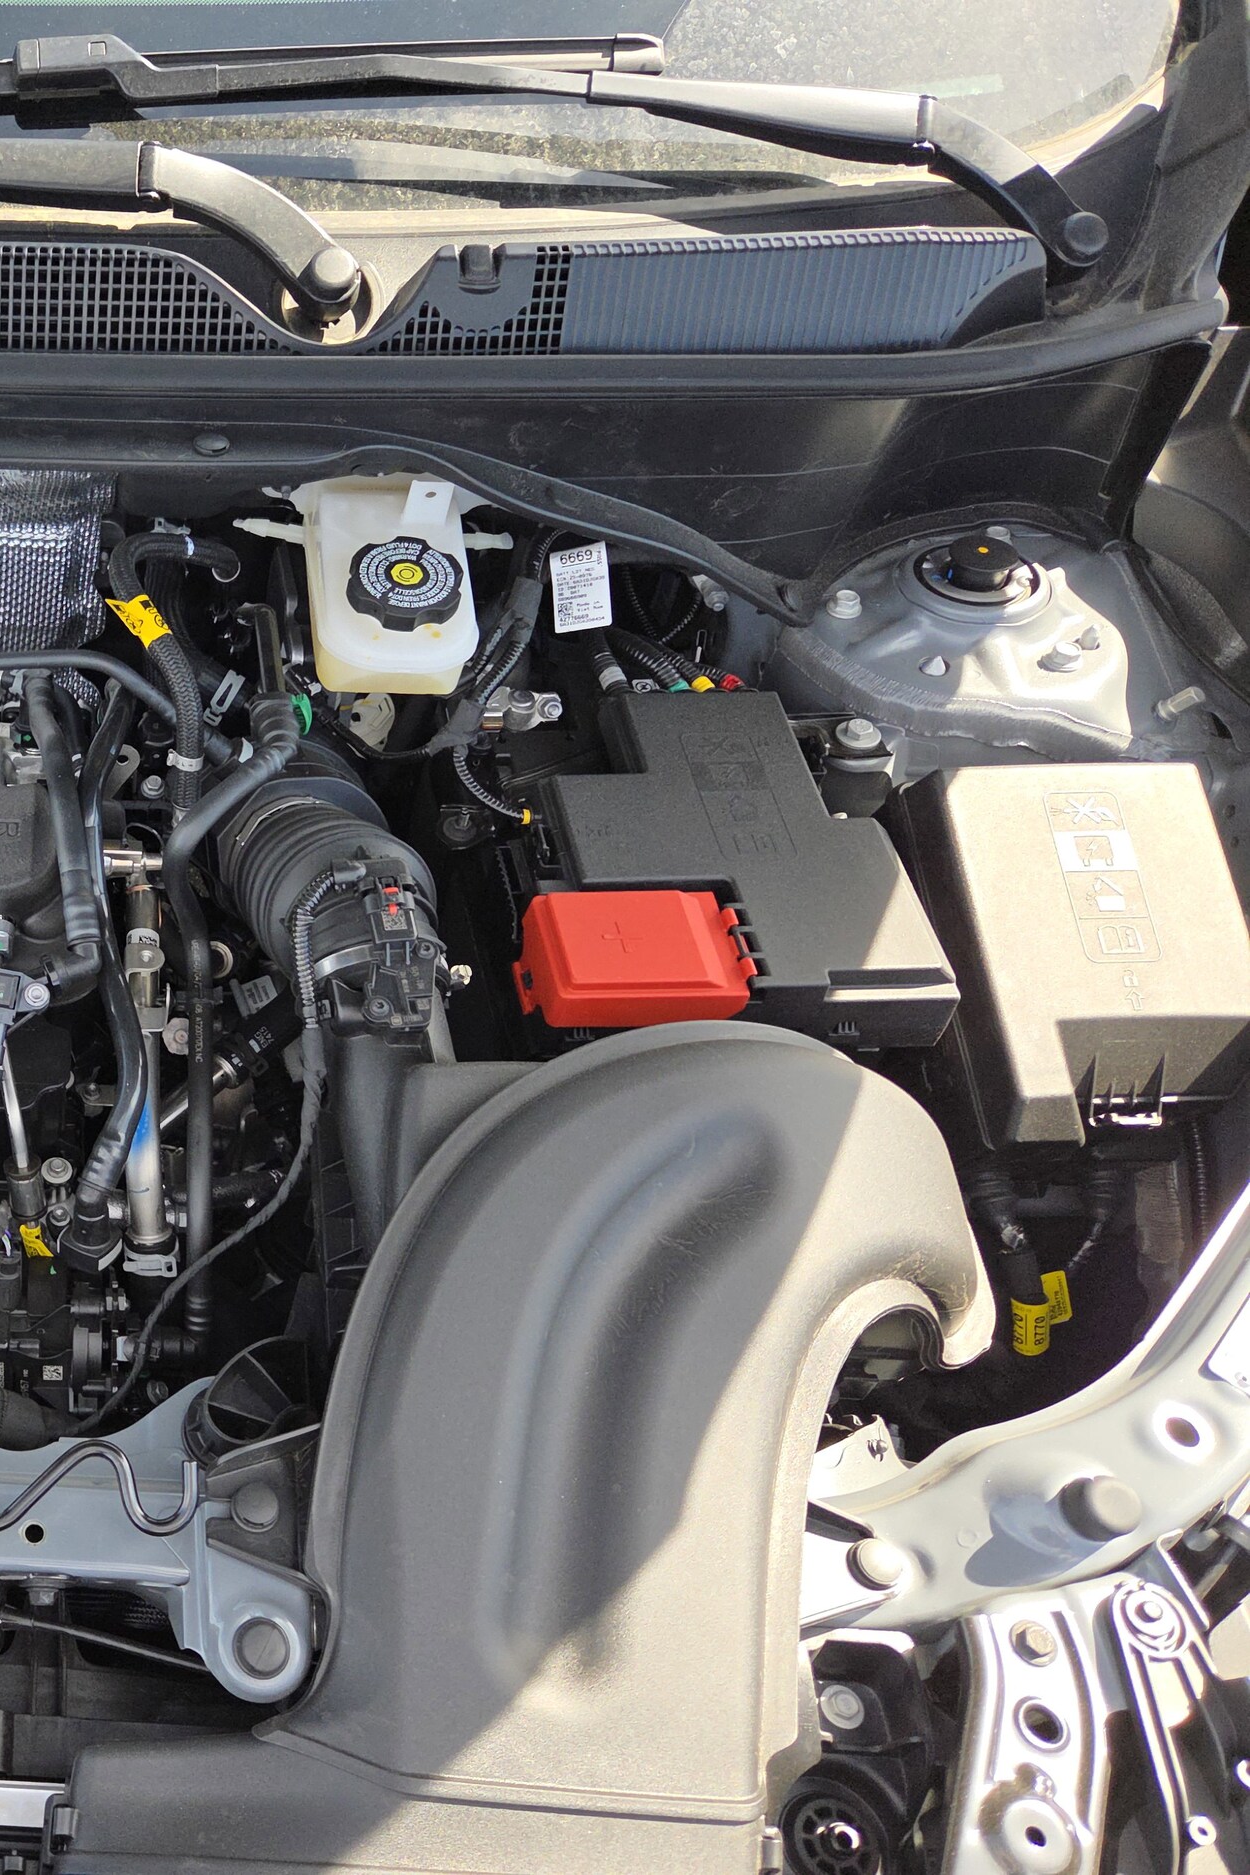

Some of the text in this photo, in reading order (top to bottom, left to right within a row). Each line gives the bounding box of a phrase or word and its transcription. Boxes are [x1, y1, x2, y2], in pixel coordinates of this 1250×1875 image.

[560, 549, 593, 565] 6669
[254, 1031, 268, 1049] ENG
[1034, 1315, 1046, 1346] 8770
